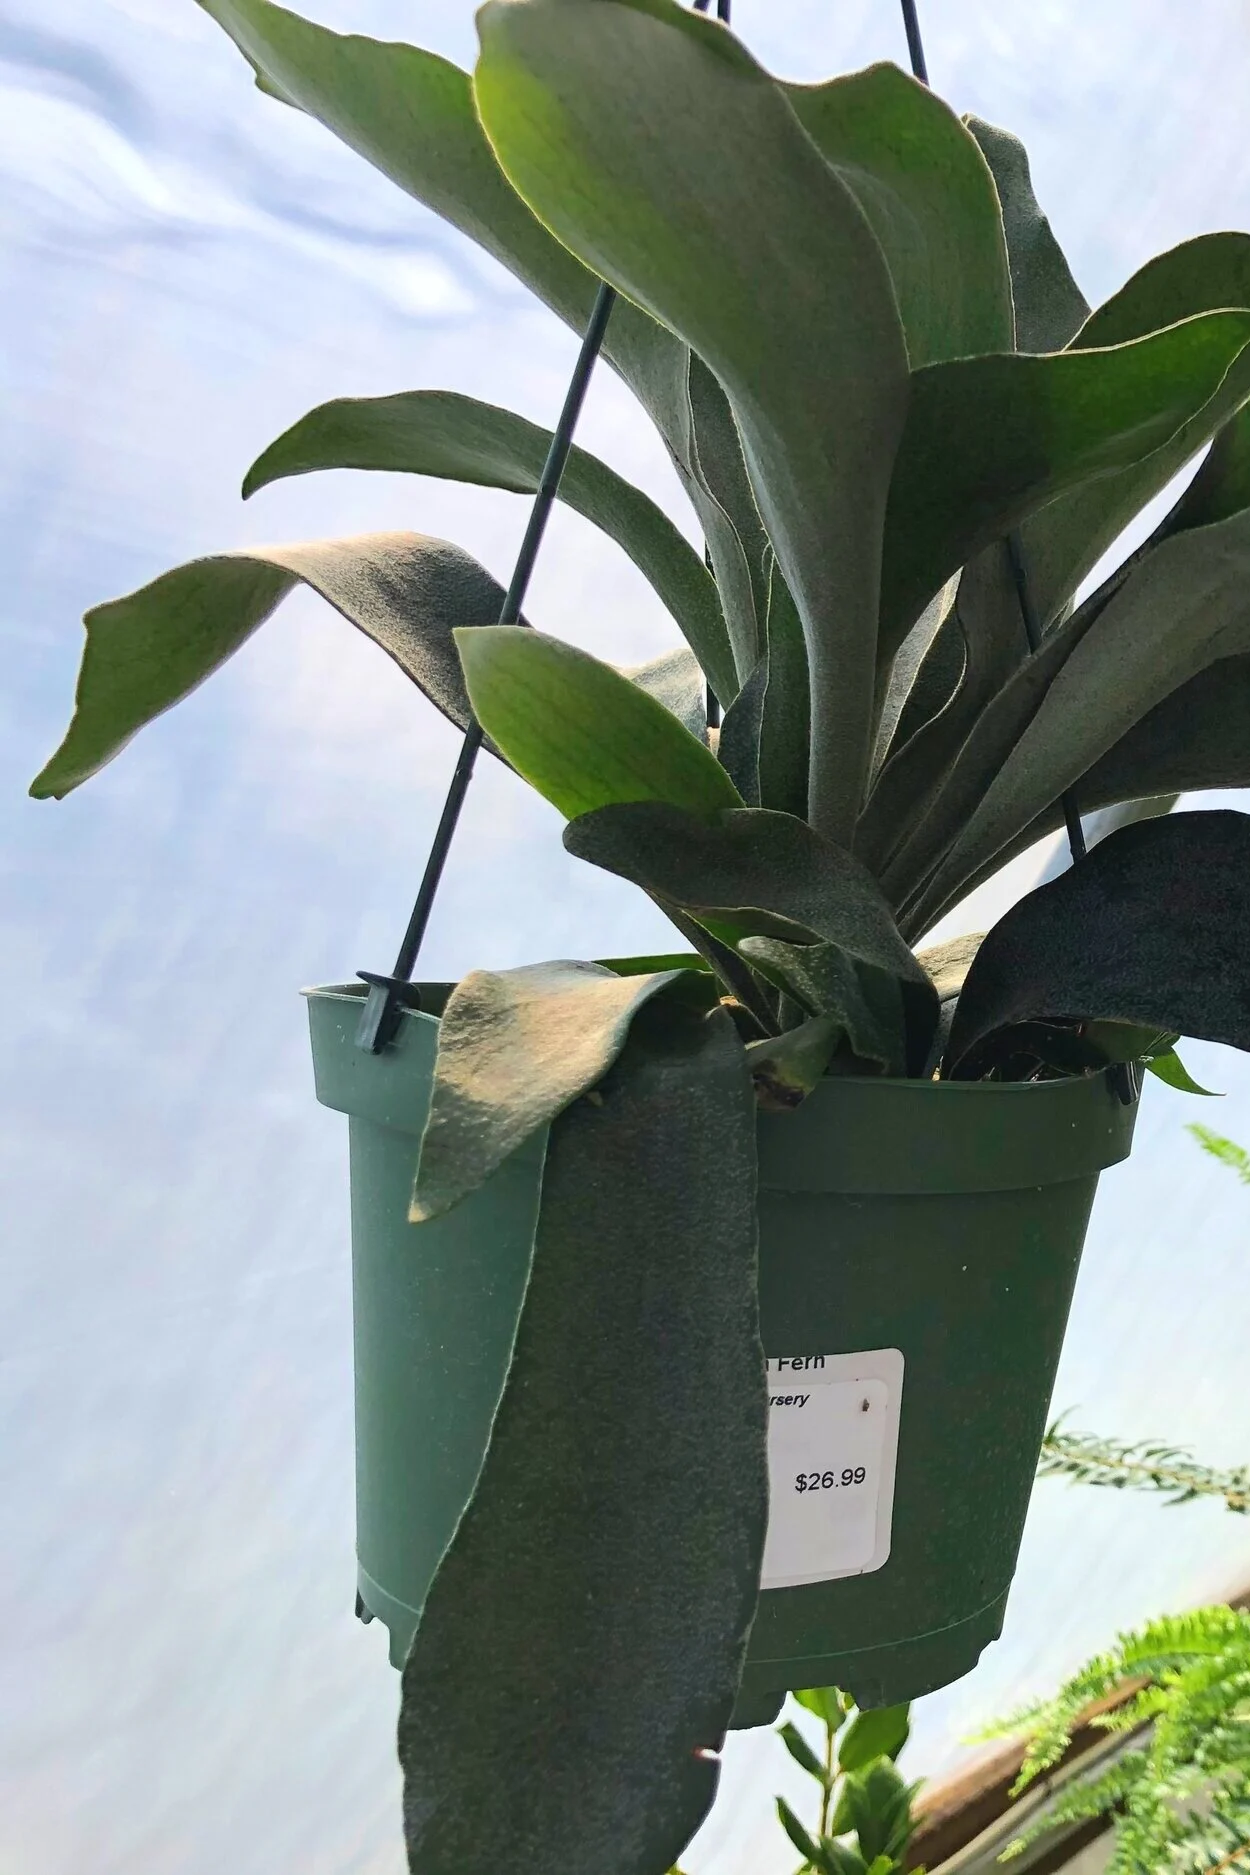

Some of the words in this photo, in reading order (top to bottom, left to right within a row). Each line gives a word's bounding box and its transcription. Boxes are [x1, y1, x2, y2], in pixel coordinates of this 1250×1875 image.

[778, 1355, 825, 1371] Fern
[768, 1394, 811, 1408] rsery
[795, 1467, 866, 1494] $26.99
